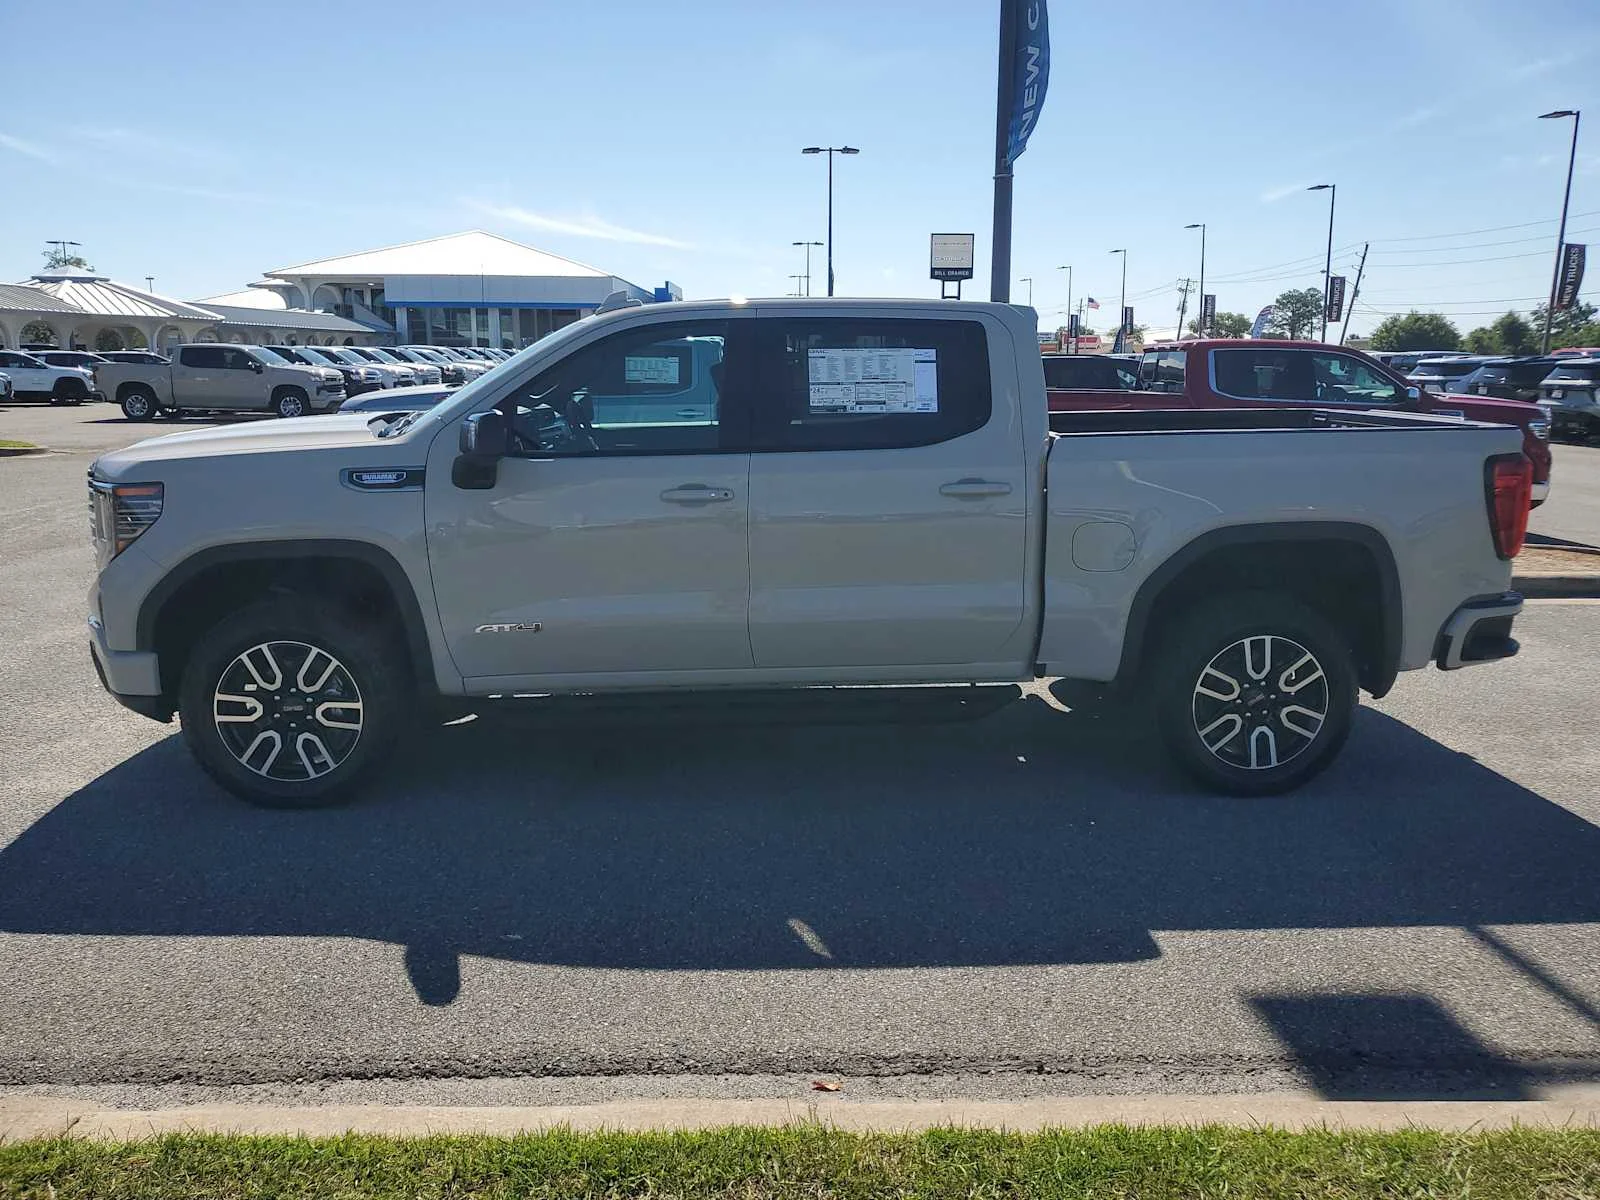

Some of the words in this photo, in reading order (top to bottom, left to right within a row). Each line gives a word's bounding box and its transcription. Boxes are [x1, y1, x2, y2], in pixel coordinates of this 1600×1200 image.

[1018, 45, 1040, 142] NEW
[1567, 247, 1579, 282] TRUCKS
[474, 622, 543, 633] AT4
